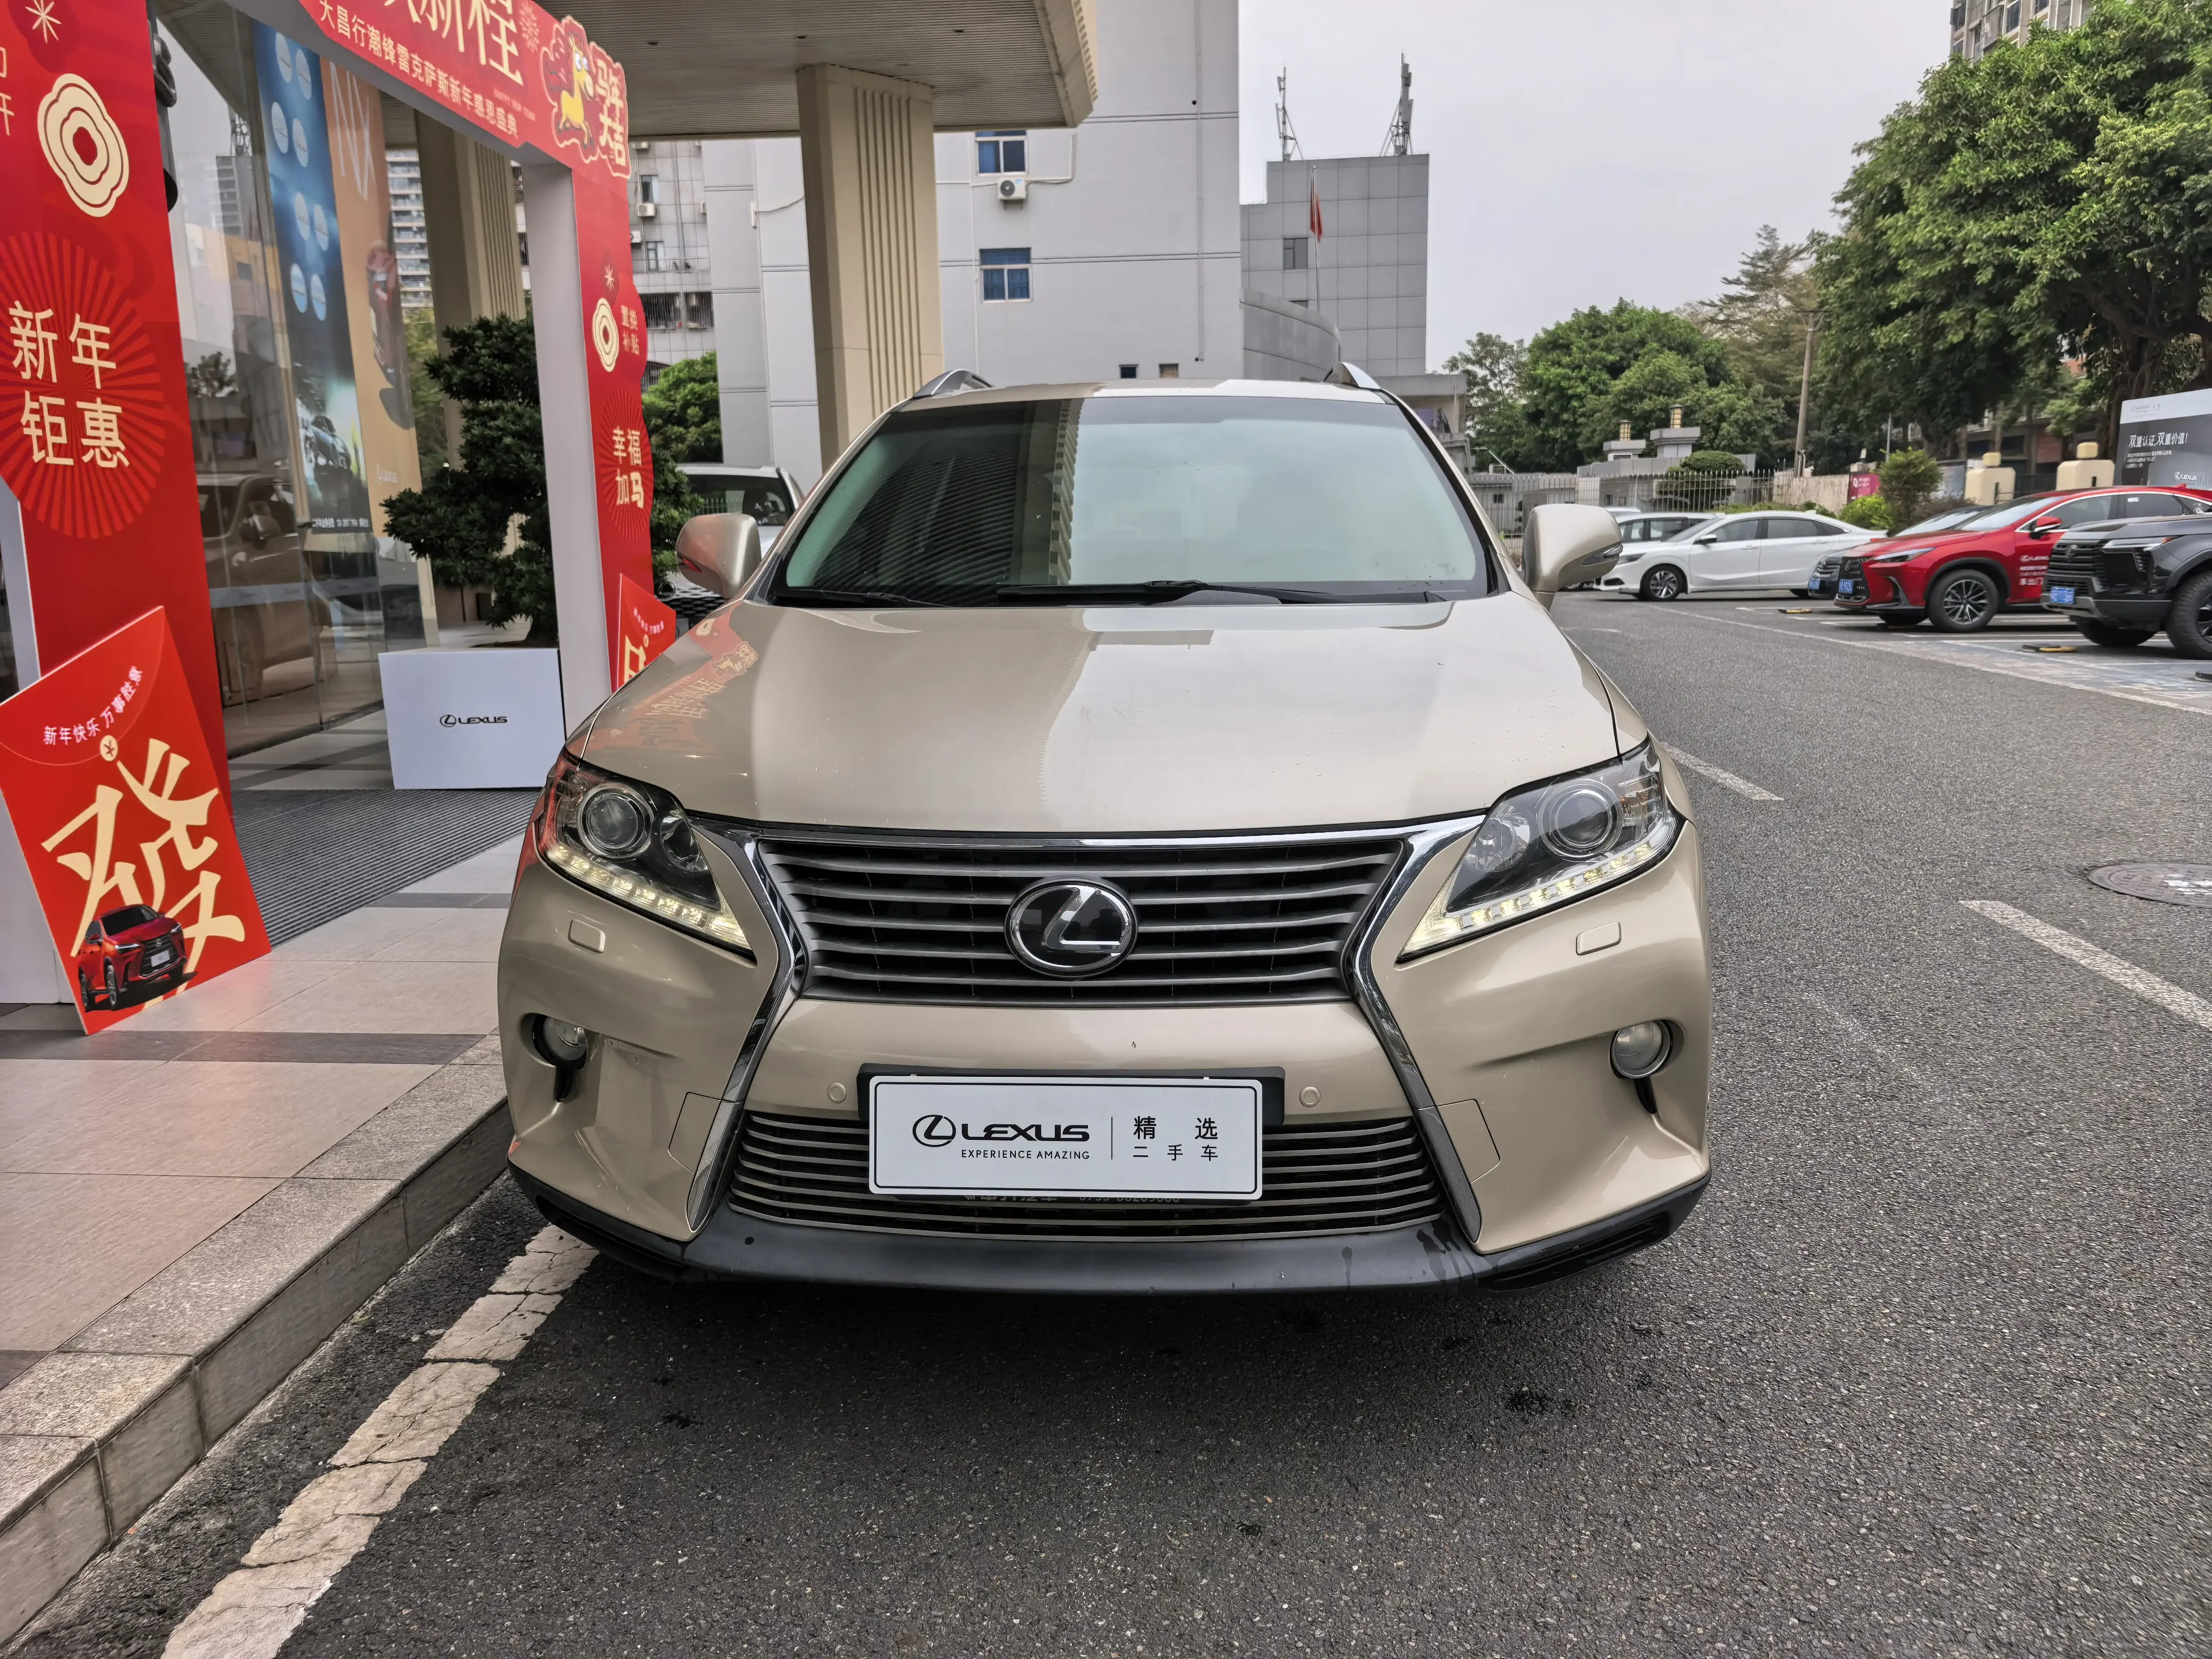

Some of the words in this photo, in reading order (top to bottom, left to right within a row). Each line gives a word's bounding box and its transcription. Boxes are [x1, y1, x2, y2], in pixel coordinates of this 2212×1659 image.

[382, 0, 524, 86] 新程
[9, 300, 117, 389] 新年
[21, 390, 130, 468] 钜惠
[612, 425, 642, 467] 幸福
[615, 468, 645, 509] 加马
[43, 717, 101, 746] 新年快乐
[99, 665, 144, 729] 万事胜意
[458, 716, 508, 724] LEXUS
[961, 1123, 1090, 1142] LEXUS
[1133, 1116, 1218, 1140] 精选
[961, 1149, 1032, 1159] EXPERIENCE
[1036, 1150, 1090, 1159] AMAZING
[1132, 1144, 1218, 1162] 二手车
